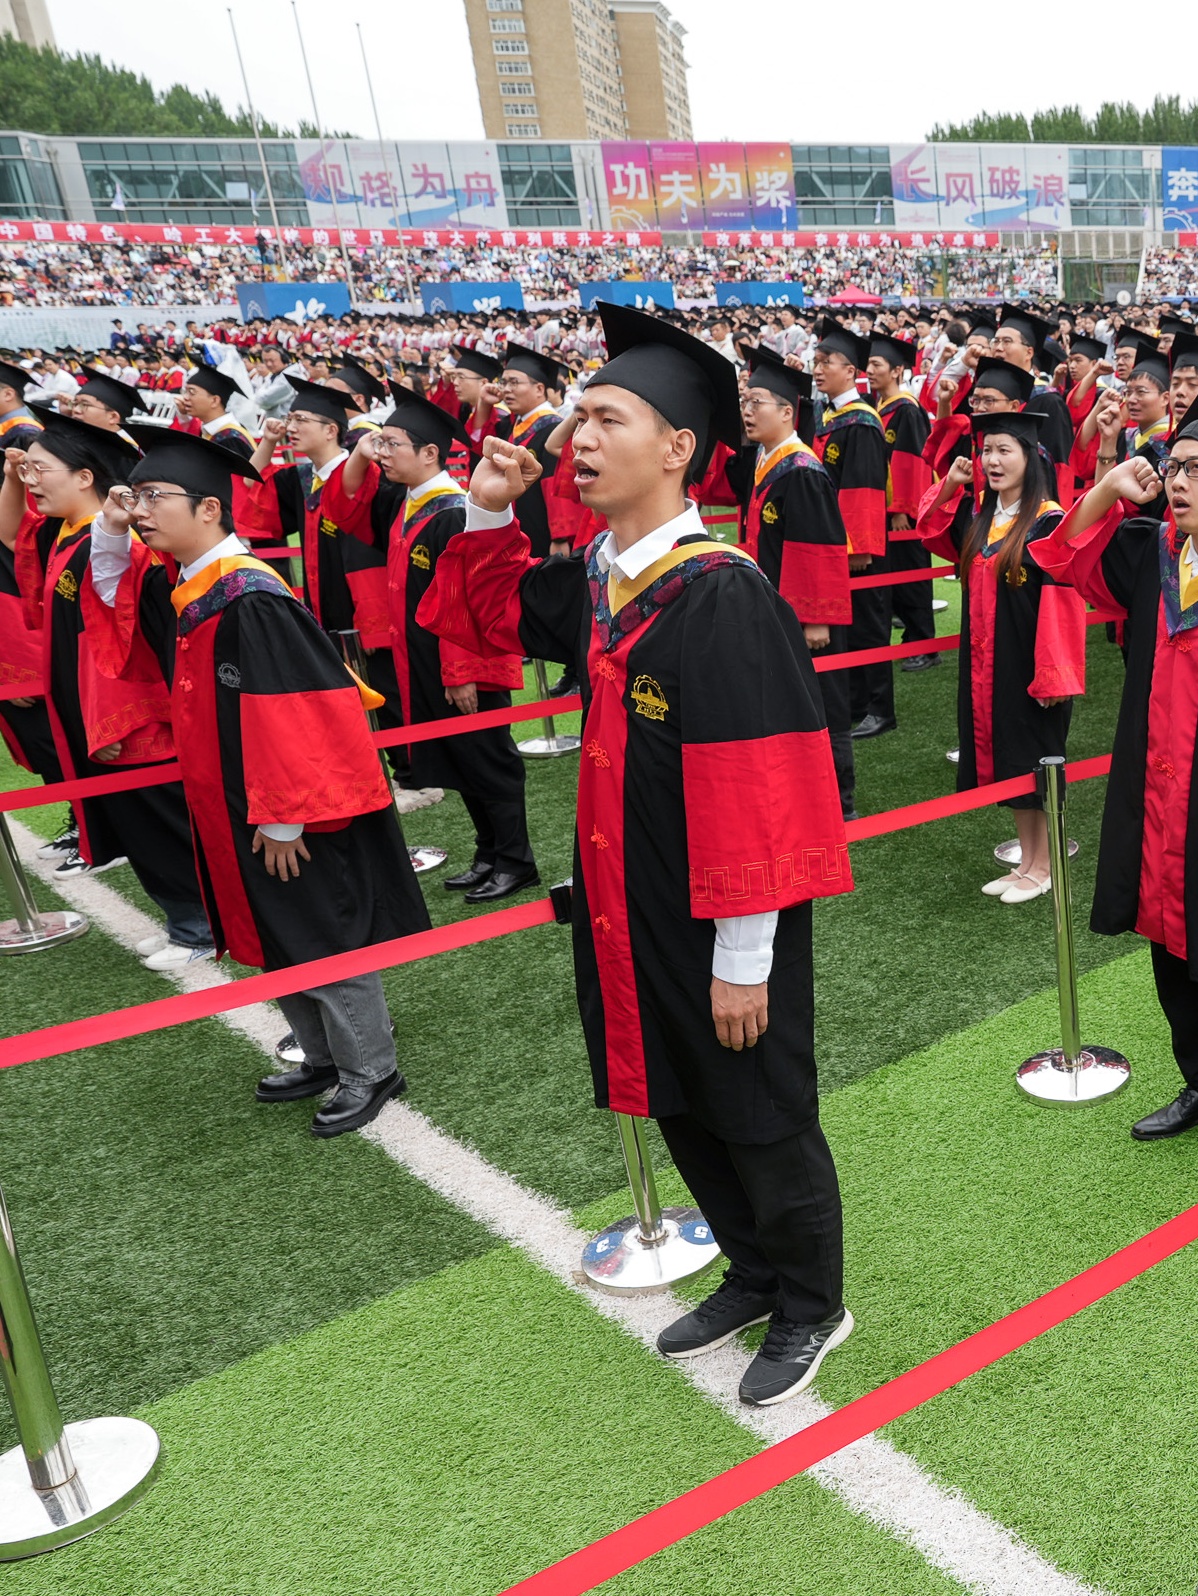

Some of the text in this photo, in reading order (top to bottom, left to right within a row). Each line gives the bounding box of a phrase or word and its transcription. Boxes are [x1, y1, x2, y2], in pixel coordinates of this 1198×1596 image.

[307, 162, 497, 208] 规格为舟
[609, 161, 792, 208] 功夫为桨
[900, 165, 1065, 207] 长风破浪
